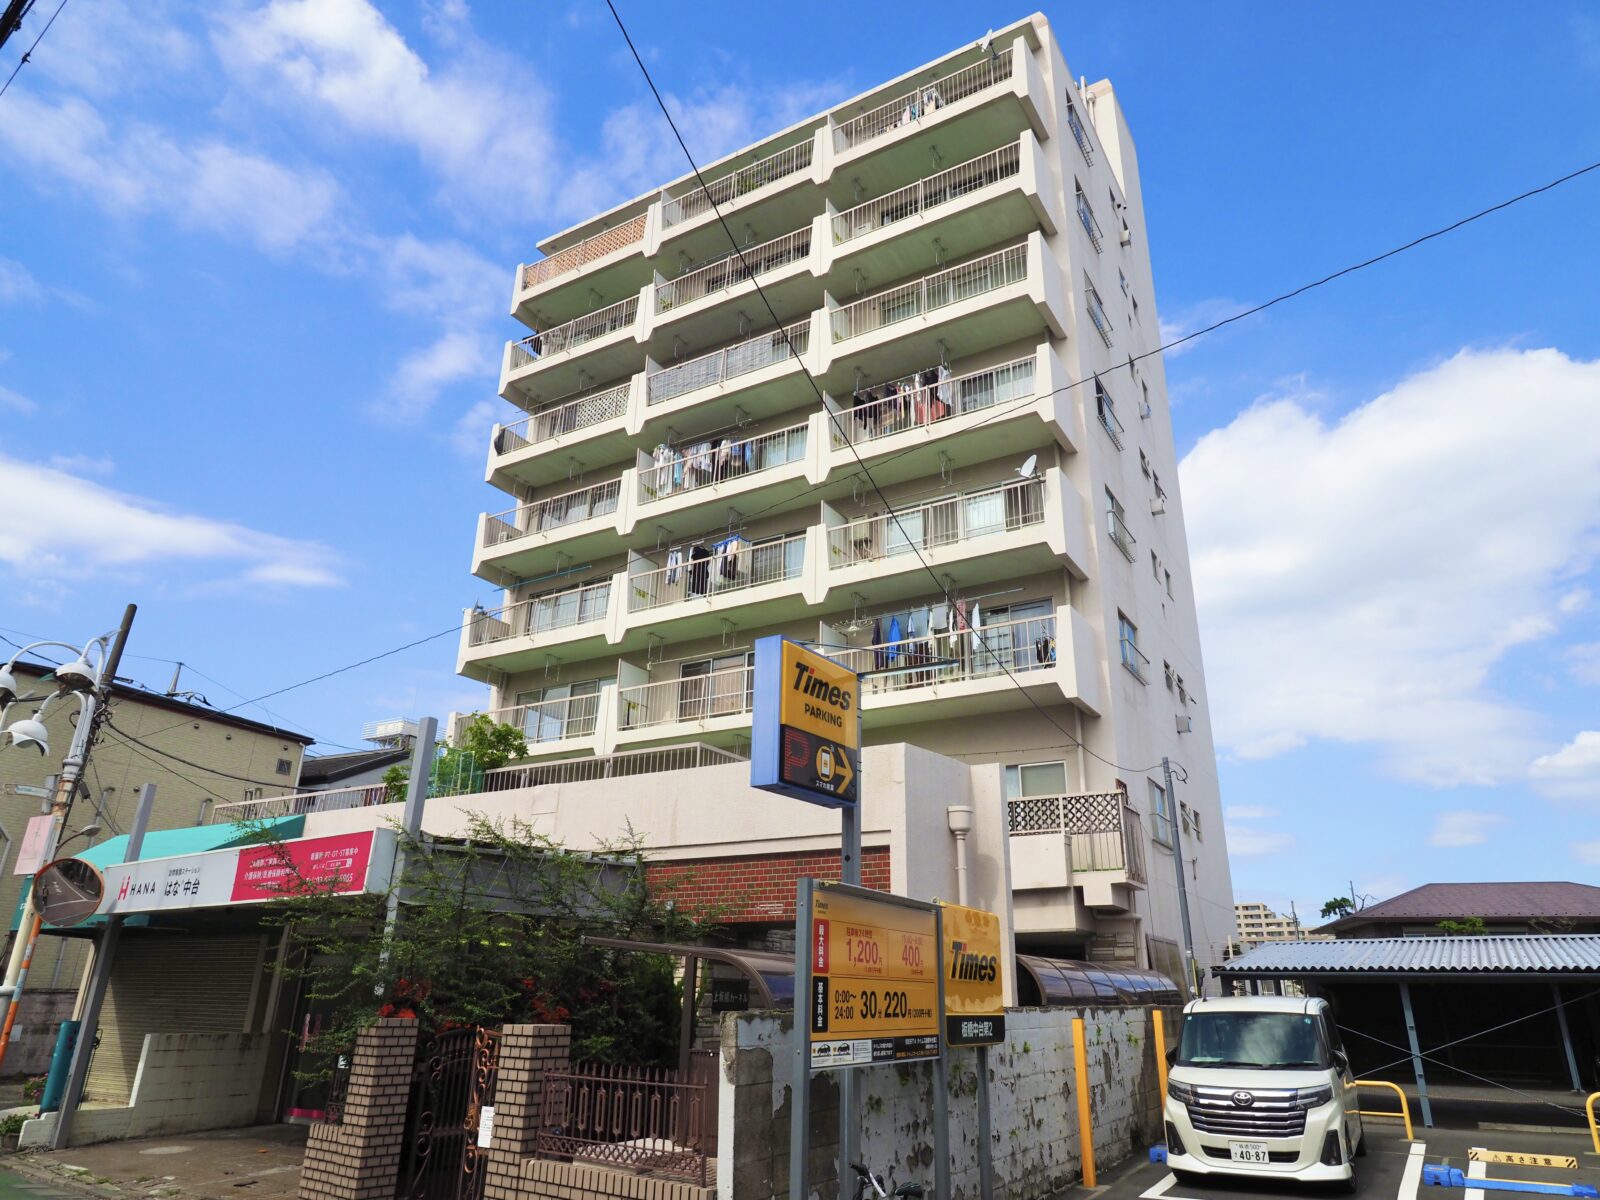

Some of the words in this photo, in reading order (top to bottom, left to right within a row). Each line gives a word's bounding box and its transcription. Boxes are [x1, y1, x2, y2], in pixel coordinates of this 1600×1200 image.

[793, 661, 852, 711] Times
[804, 702, 843, 728] PARKING
[783, 728, 812, 781] P
[130, 881, 156, 896] HANA
[950, 940, 998, 982] Times
[834, 1006, 854, 1019] 24:00
[1239, 1150, 1266, 1161] 40-87
[1505, 1154, 1553, 1166] 高さ注意
